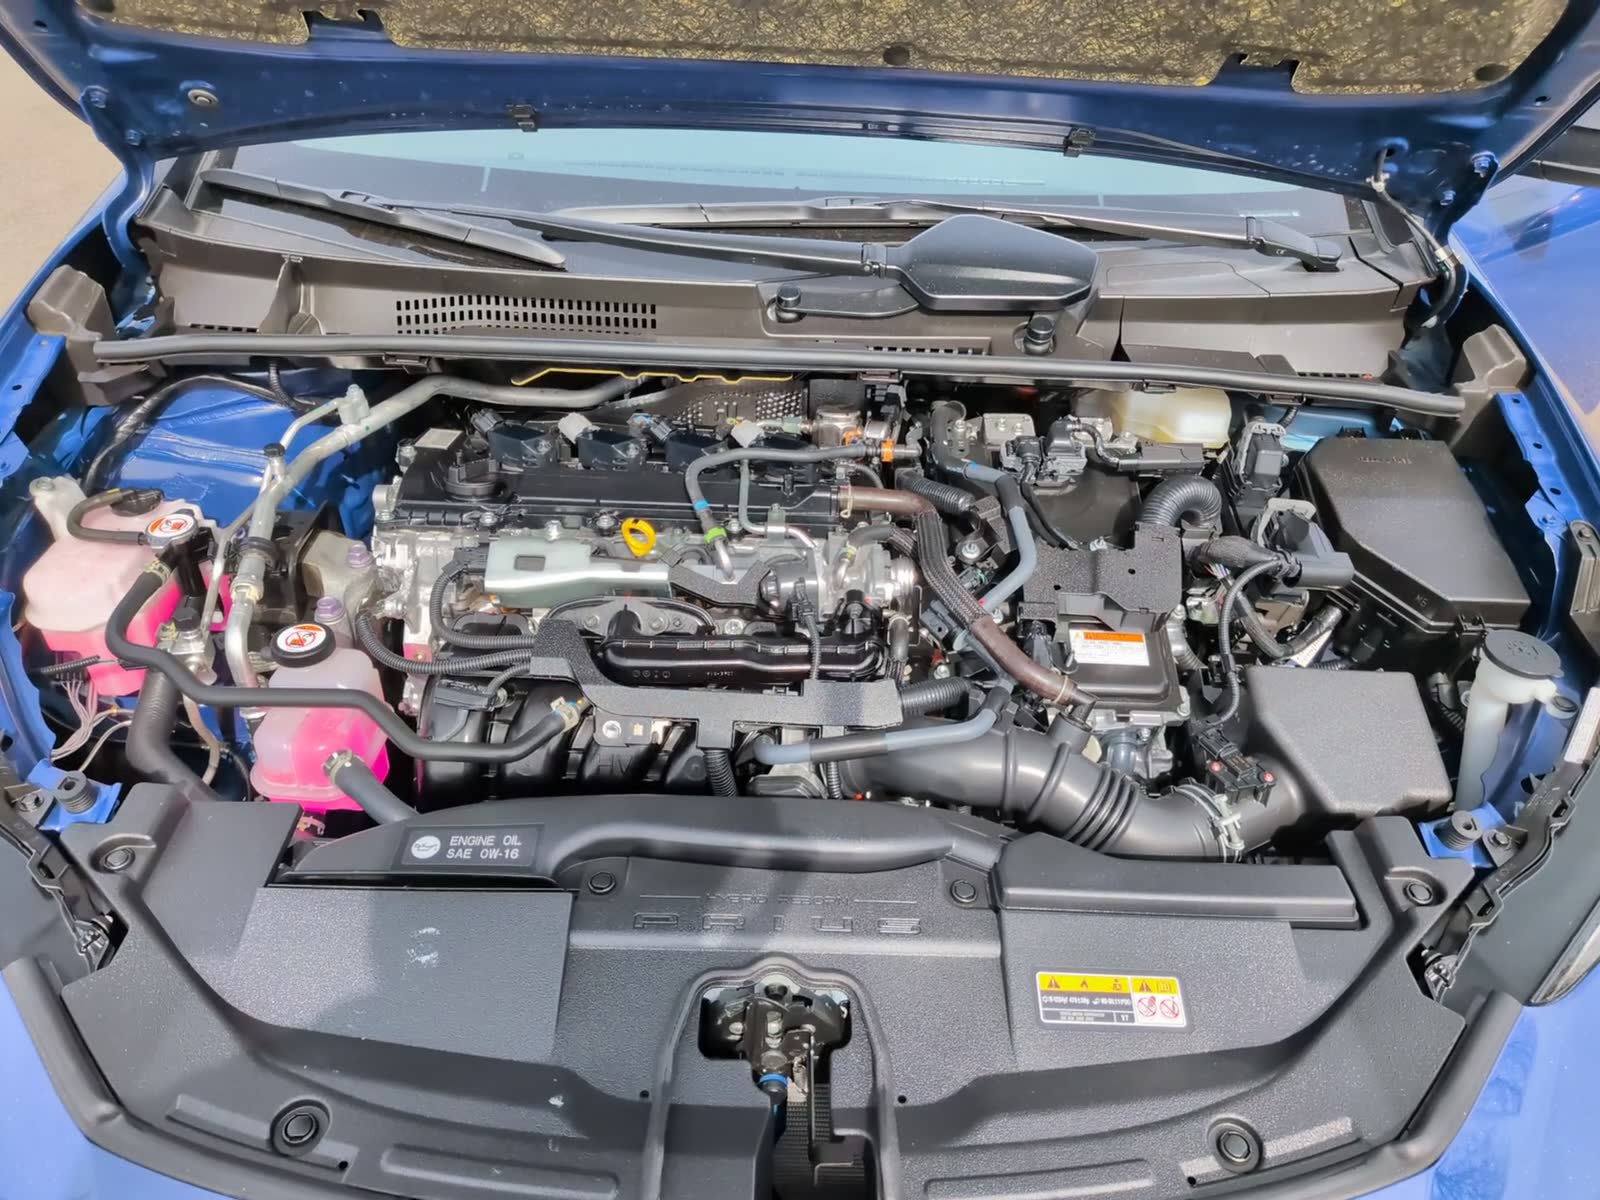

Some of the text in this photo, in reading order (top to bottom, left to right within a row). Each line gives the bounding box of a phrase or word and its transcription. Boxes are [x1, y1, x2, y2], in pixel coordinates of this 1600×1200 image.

[450, 834, 522, 846] ENGINE OIL
[446, 848, 519, 859] SAE 0W-16
[633, 912, 921, 934] PRIUS
